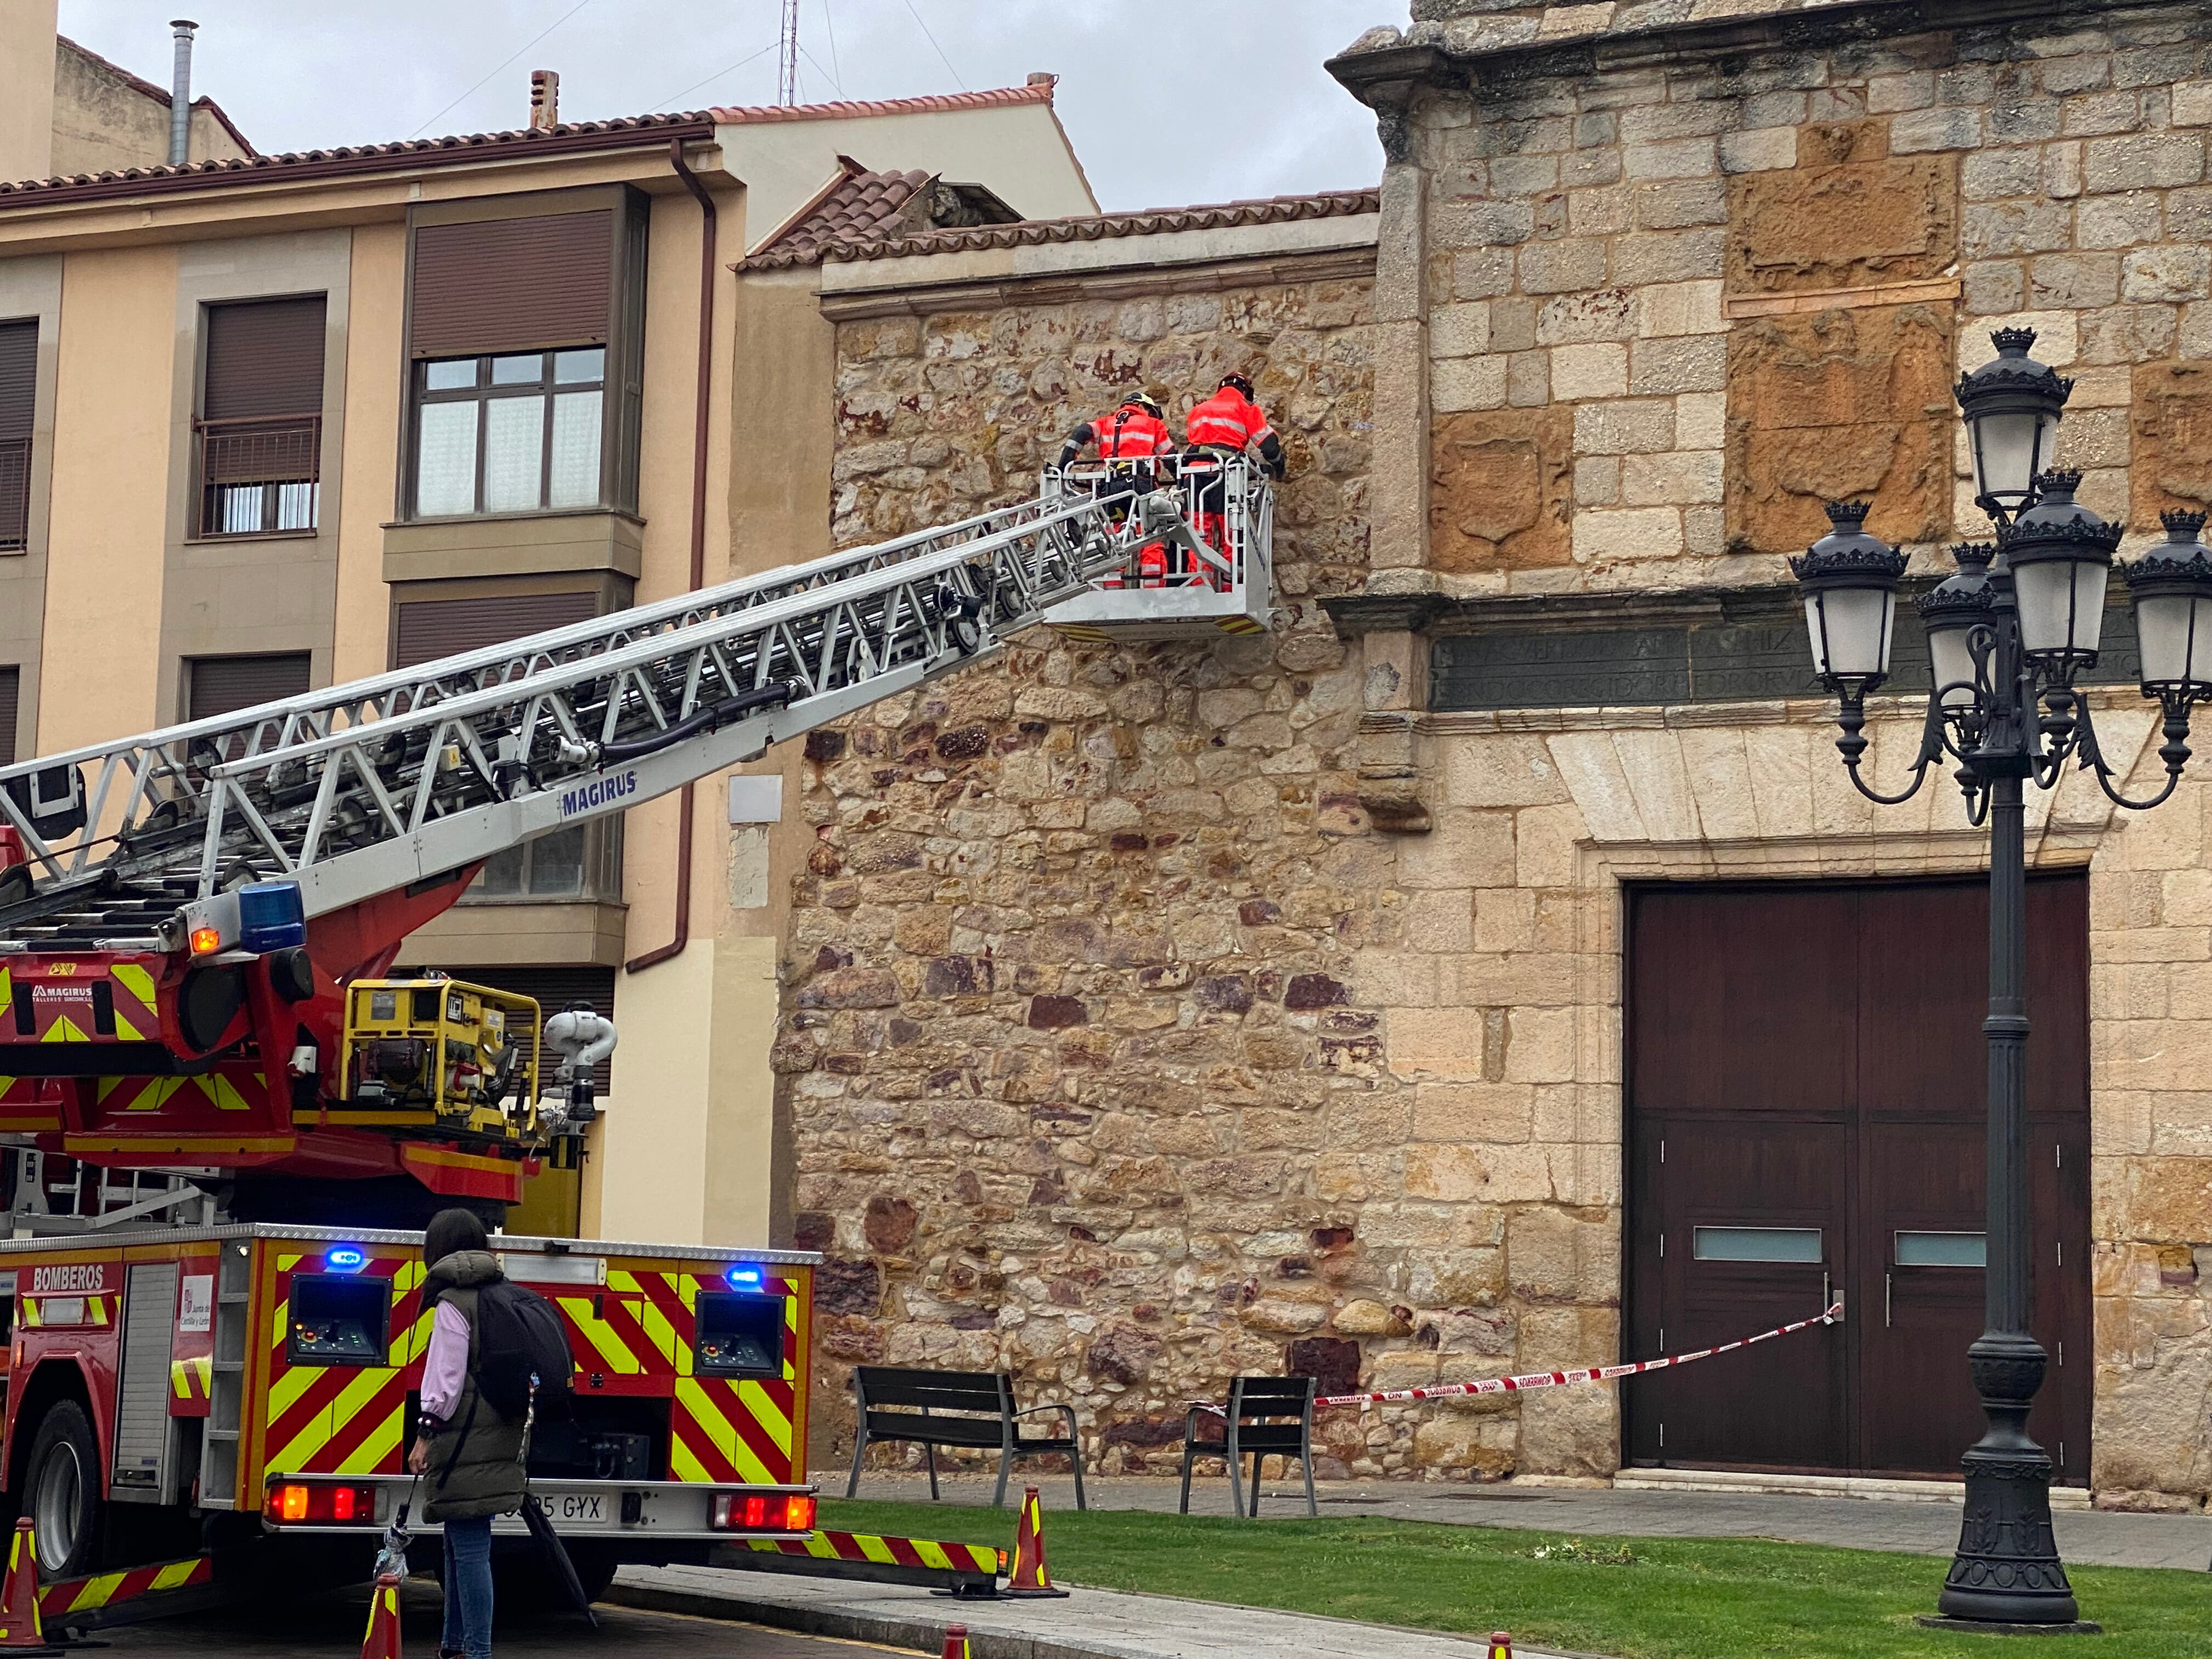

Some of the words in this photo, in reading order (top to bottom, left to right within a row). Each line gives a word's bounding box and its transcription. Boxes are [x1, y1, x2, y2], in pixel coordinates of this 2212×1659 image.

[563, 771, 635, 816] MAGIRUS
[47, 988, 93, 996] MAGIRUS
[33, 1265, 103, 1291] BOMBEROS
[192, 1305, 204, 1313] Junta
[1519, 1375, 1551, 1388] BOMBEROS
[563, 1496, 600, 1518] GYX
